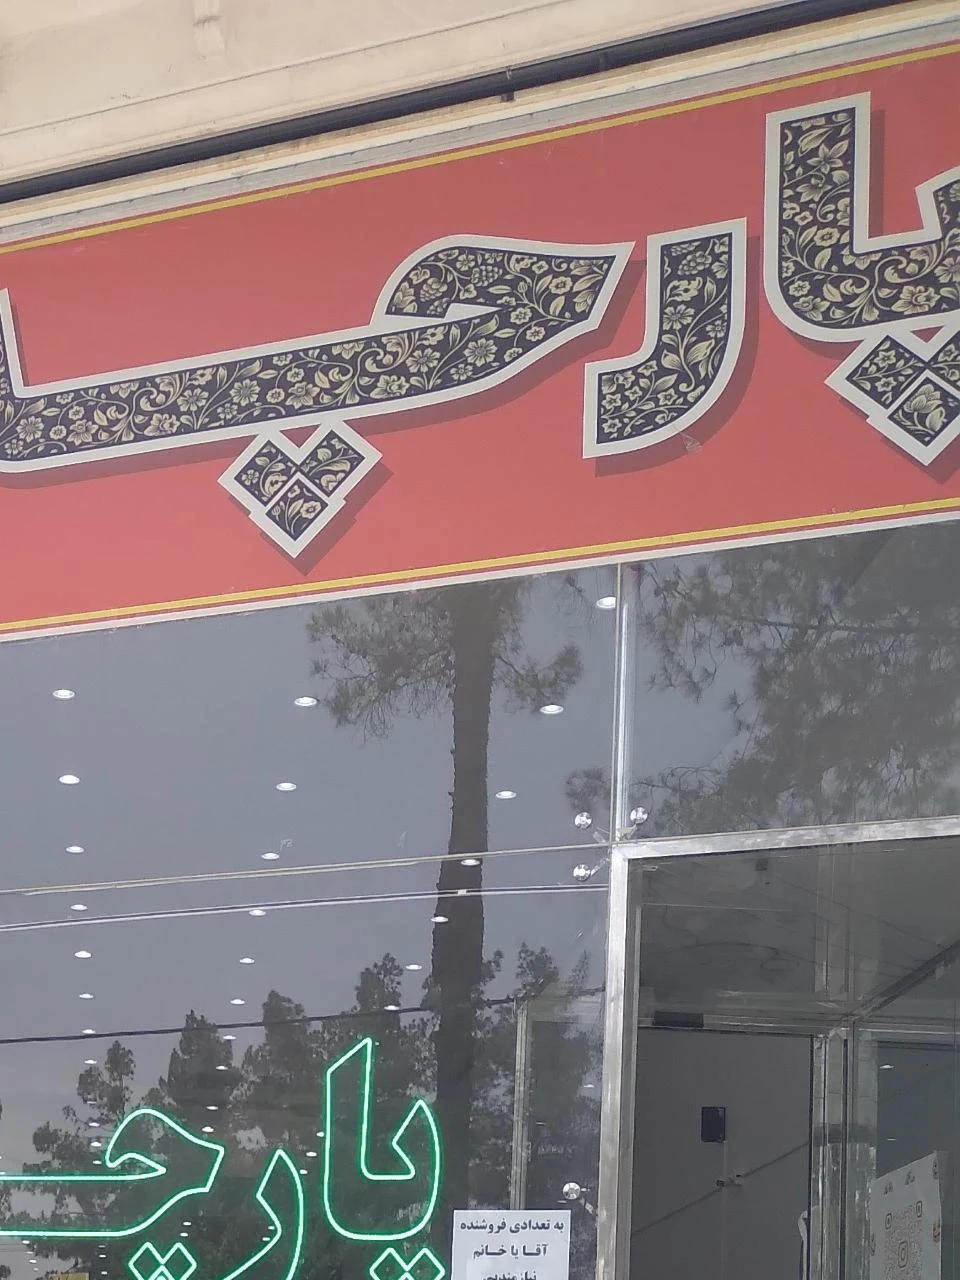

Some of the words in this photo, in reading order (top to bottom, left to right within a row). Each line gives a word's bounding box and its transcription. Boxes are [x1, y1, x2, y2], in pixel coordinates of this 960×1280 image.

[460, 1217, 507, 1234] فروشنده
[509, 1219, 551, 1234] تعدادی
[553, 1220, 565, 1233] به
[473, 1244, 507, 1259] خانم
[510, 1244, 519, 1259] یا
[522, 1243, 549, 1256] آقا
